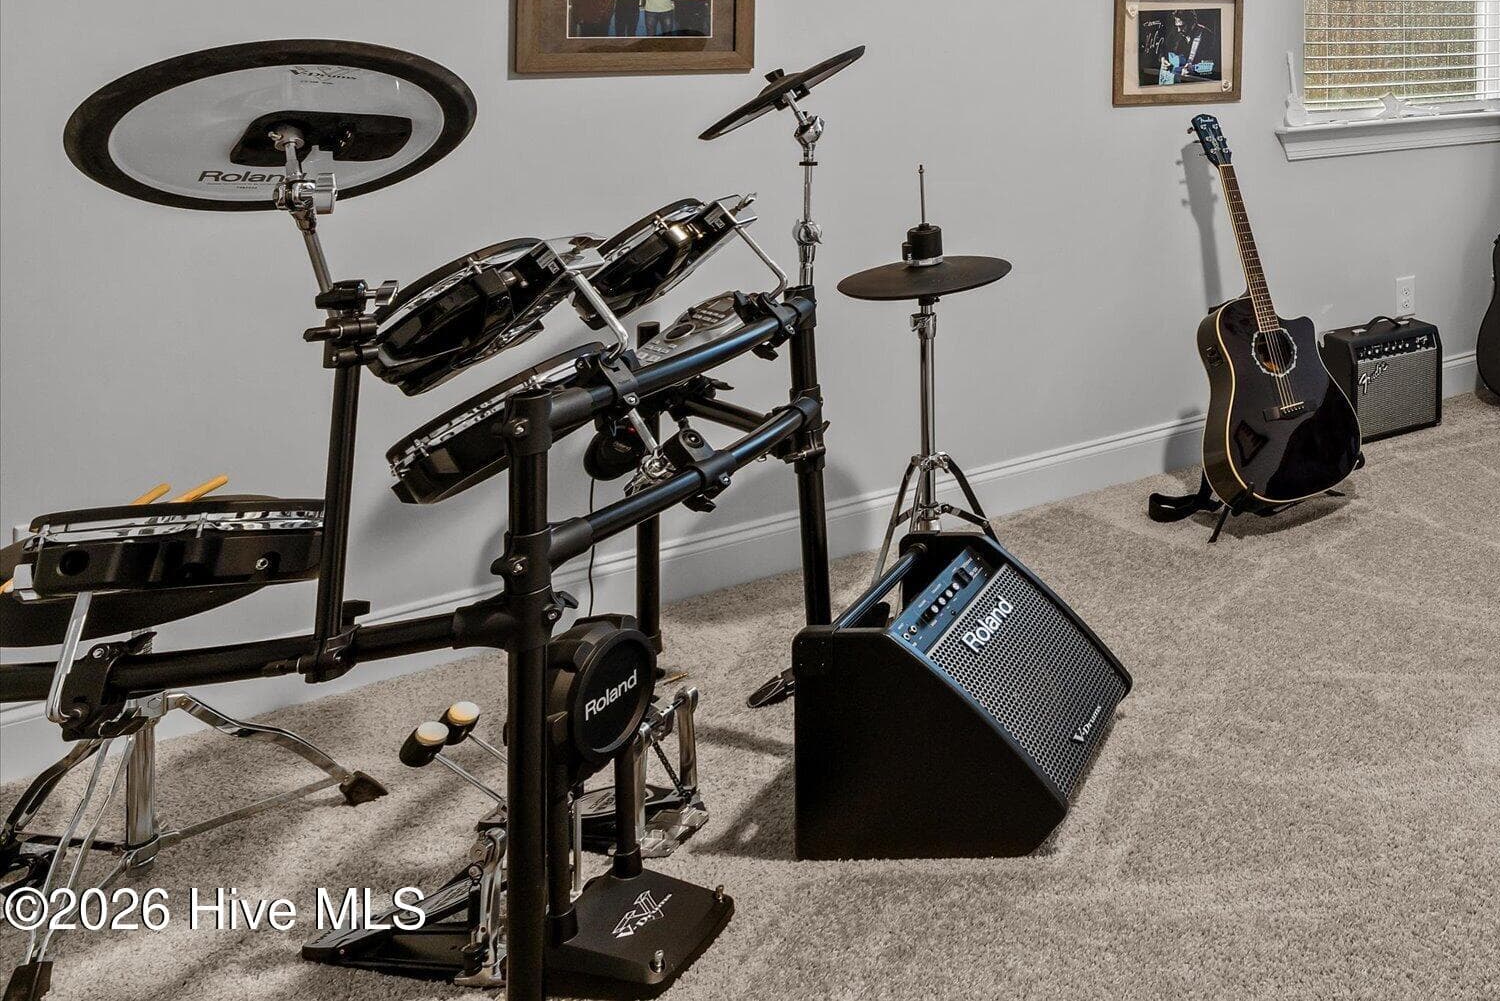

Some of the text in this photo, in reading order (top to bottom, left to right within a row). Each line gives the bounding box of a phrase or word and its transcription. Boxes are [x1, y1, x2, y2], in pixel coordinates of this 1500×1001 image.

[198, 170, 307, 182] Rolan
[961, 594, 1014, 653] Roland
[585, 668, 638, 721] Roland
